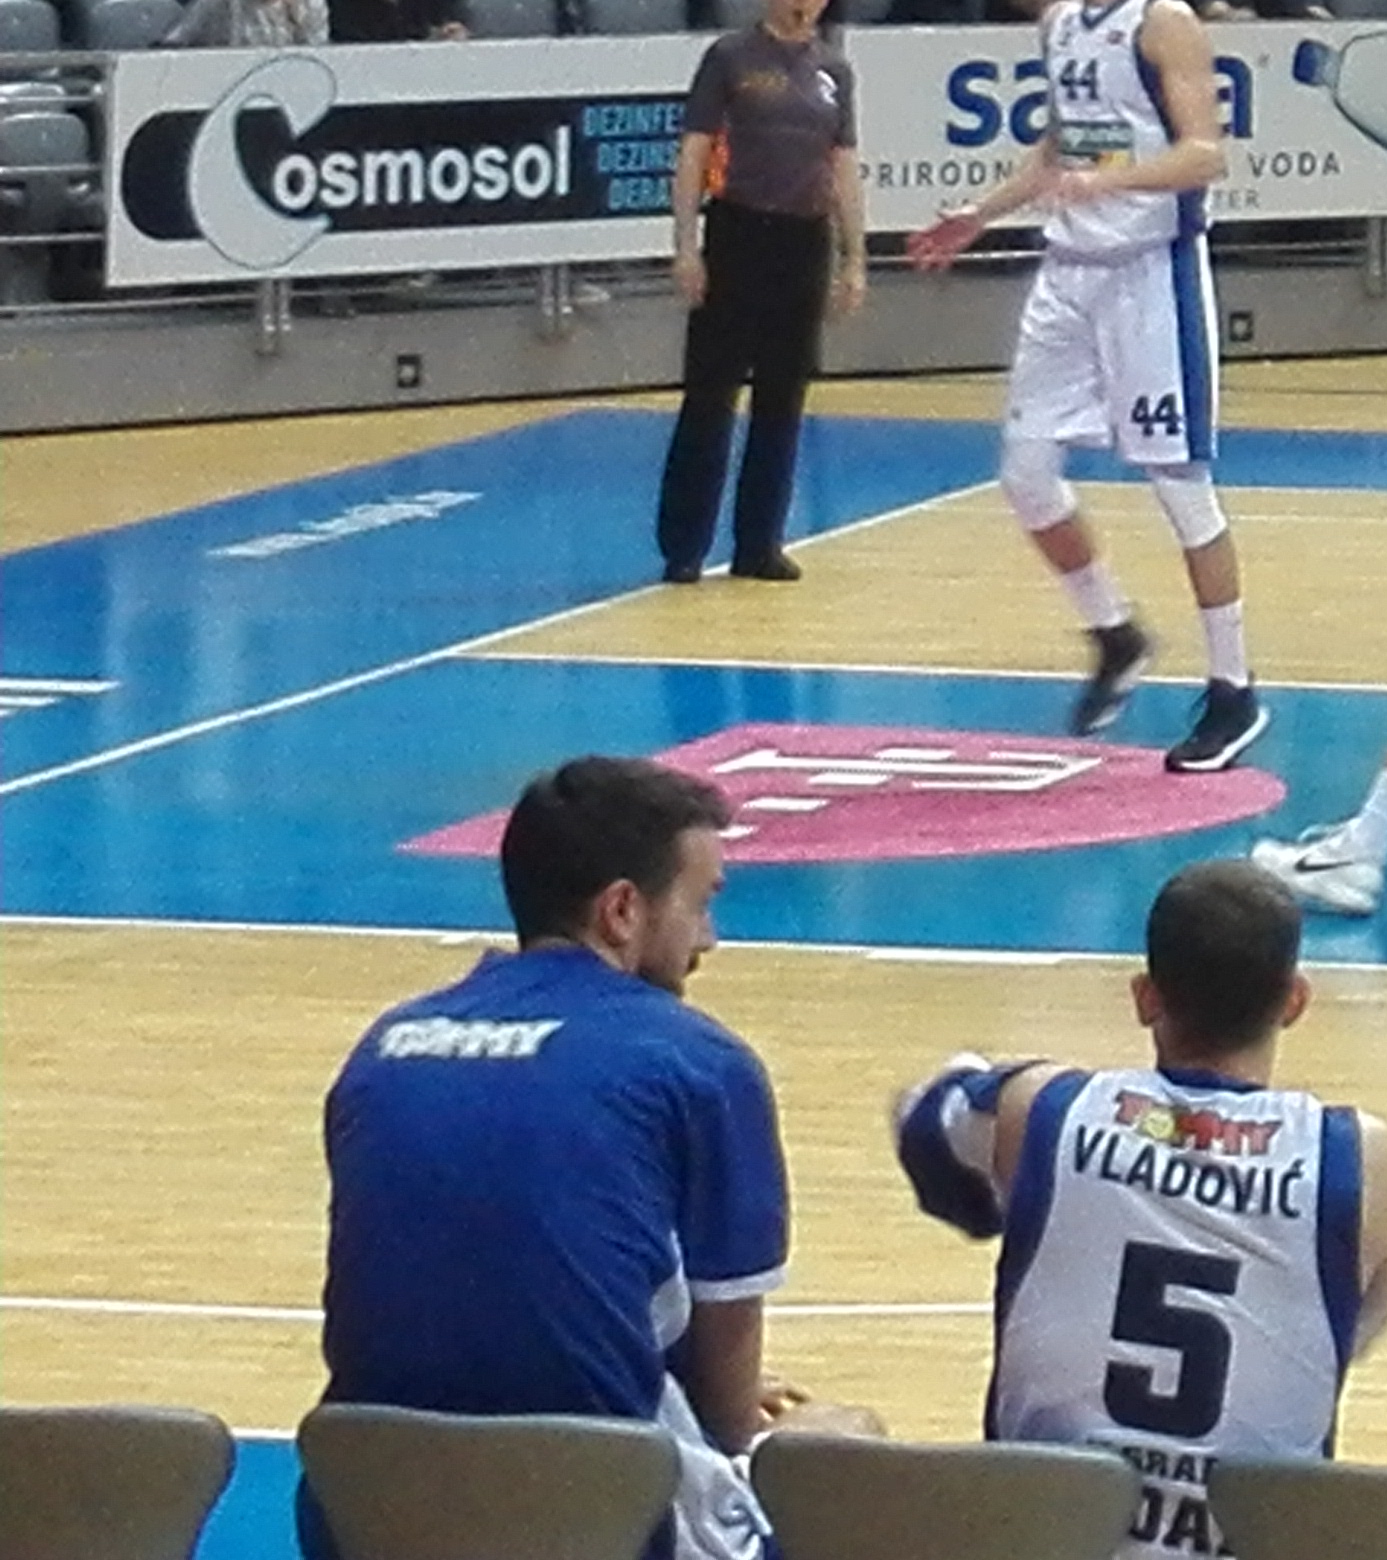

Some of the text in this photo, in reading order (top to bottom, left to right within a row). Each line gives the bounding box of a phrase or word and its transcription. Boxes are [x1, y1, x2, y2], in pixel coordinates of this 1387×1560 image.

[1060, 59, 1099, 101] 44
[583, 103, 686, 137] DEZINFE
[945, 59, 1253, 147] saa
[187, 54, 571, 269] Cosmosol
[597, 141, 679, 173] DEZINS
[860, 150, 1341, 188] PRIRODN VODA
[608, 177, 671, 210] DERA
[1212, 189, 1260, 209] TER
[1130, 392, 1183, 437] 44
[1073, 1124, 1306, 1219] VLADOVIĆ
[1103, 1239, 1241, 1439] 5
